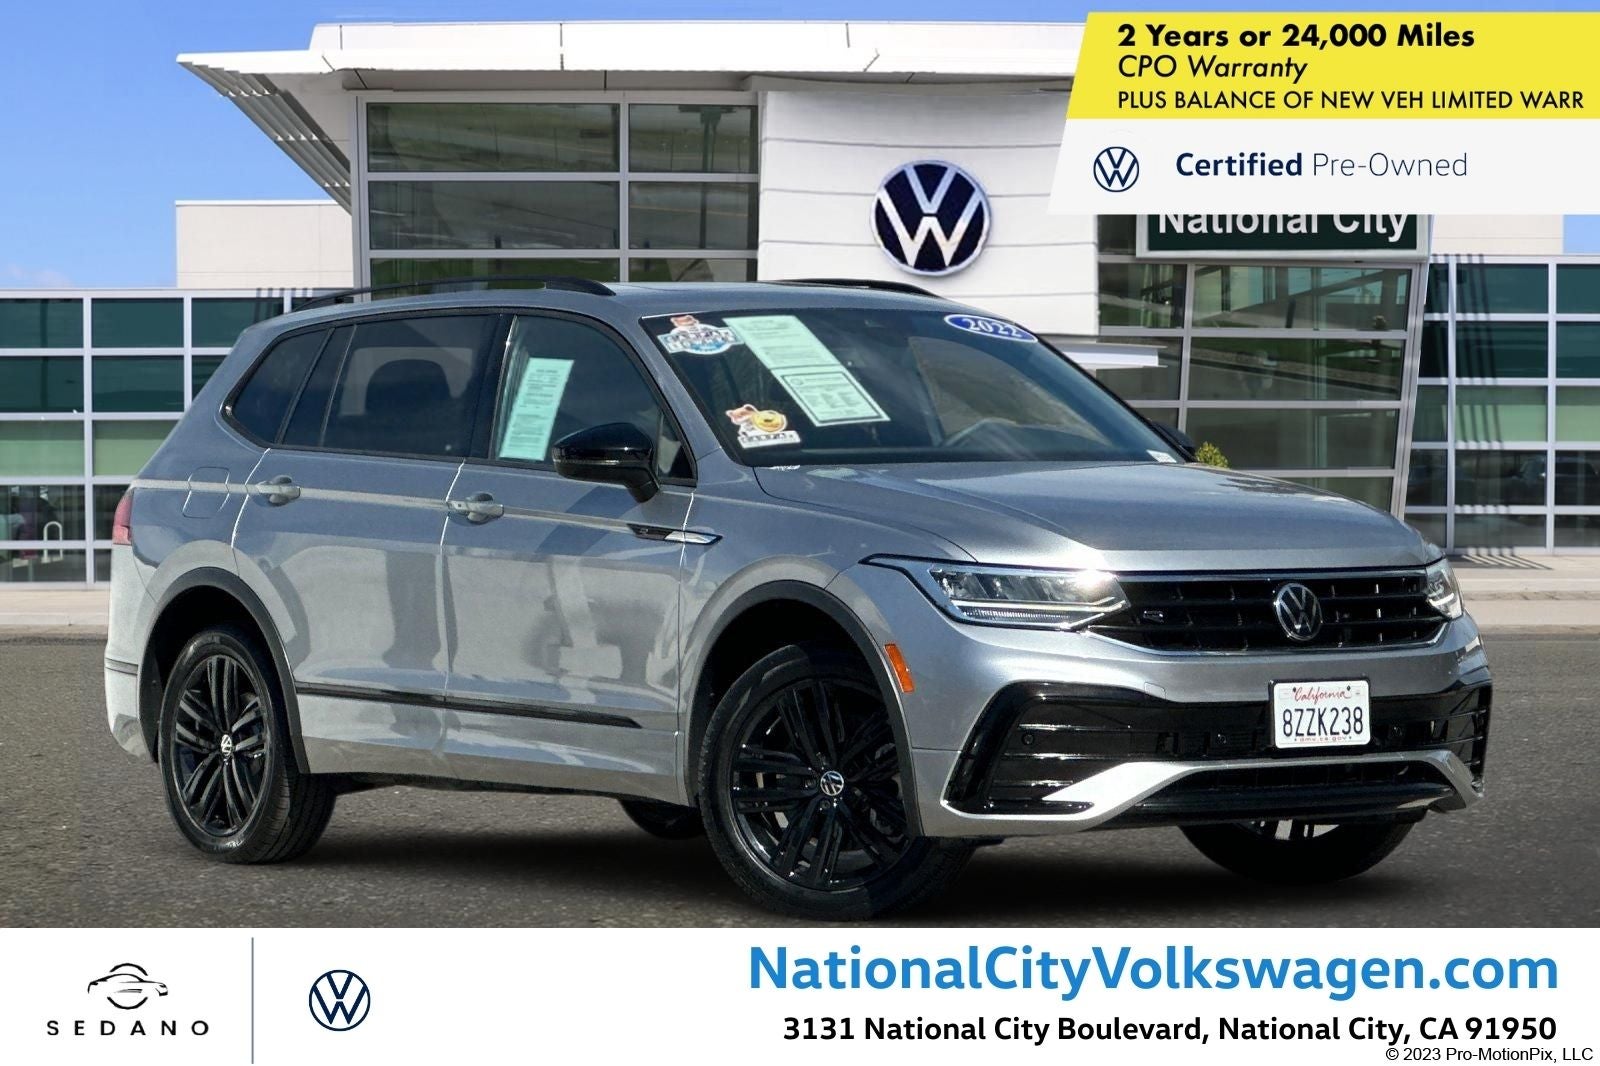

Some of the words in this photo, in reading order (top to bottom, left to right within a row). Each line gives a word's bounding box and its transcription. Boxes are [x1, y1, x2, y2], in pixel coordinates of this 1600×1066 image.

[1159, 214, 1318, 234] National
[1333, 214, 1408, 242] City
[962, 317, 1022, 338] 2022
[1294, 686, 1350, 705] California
[1283, 706, 1363, 738] 8ZZK238
